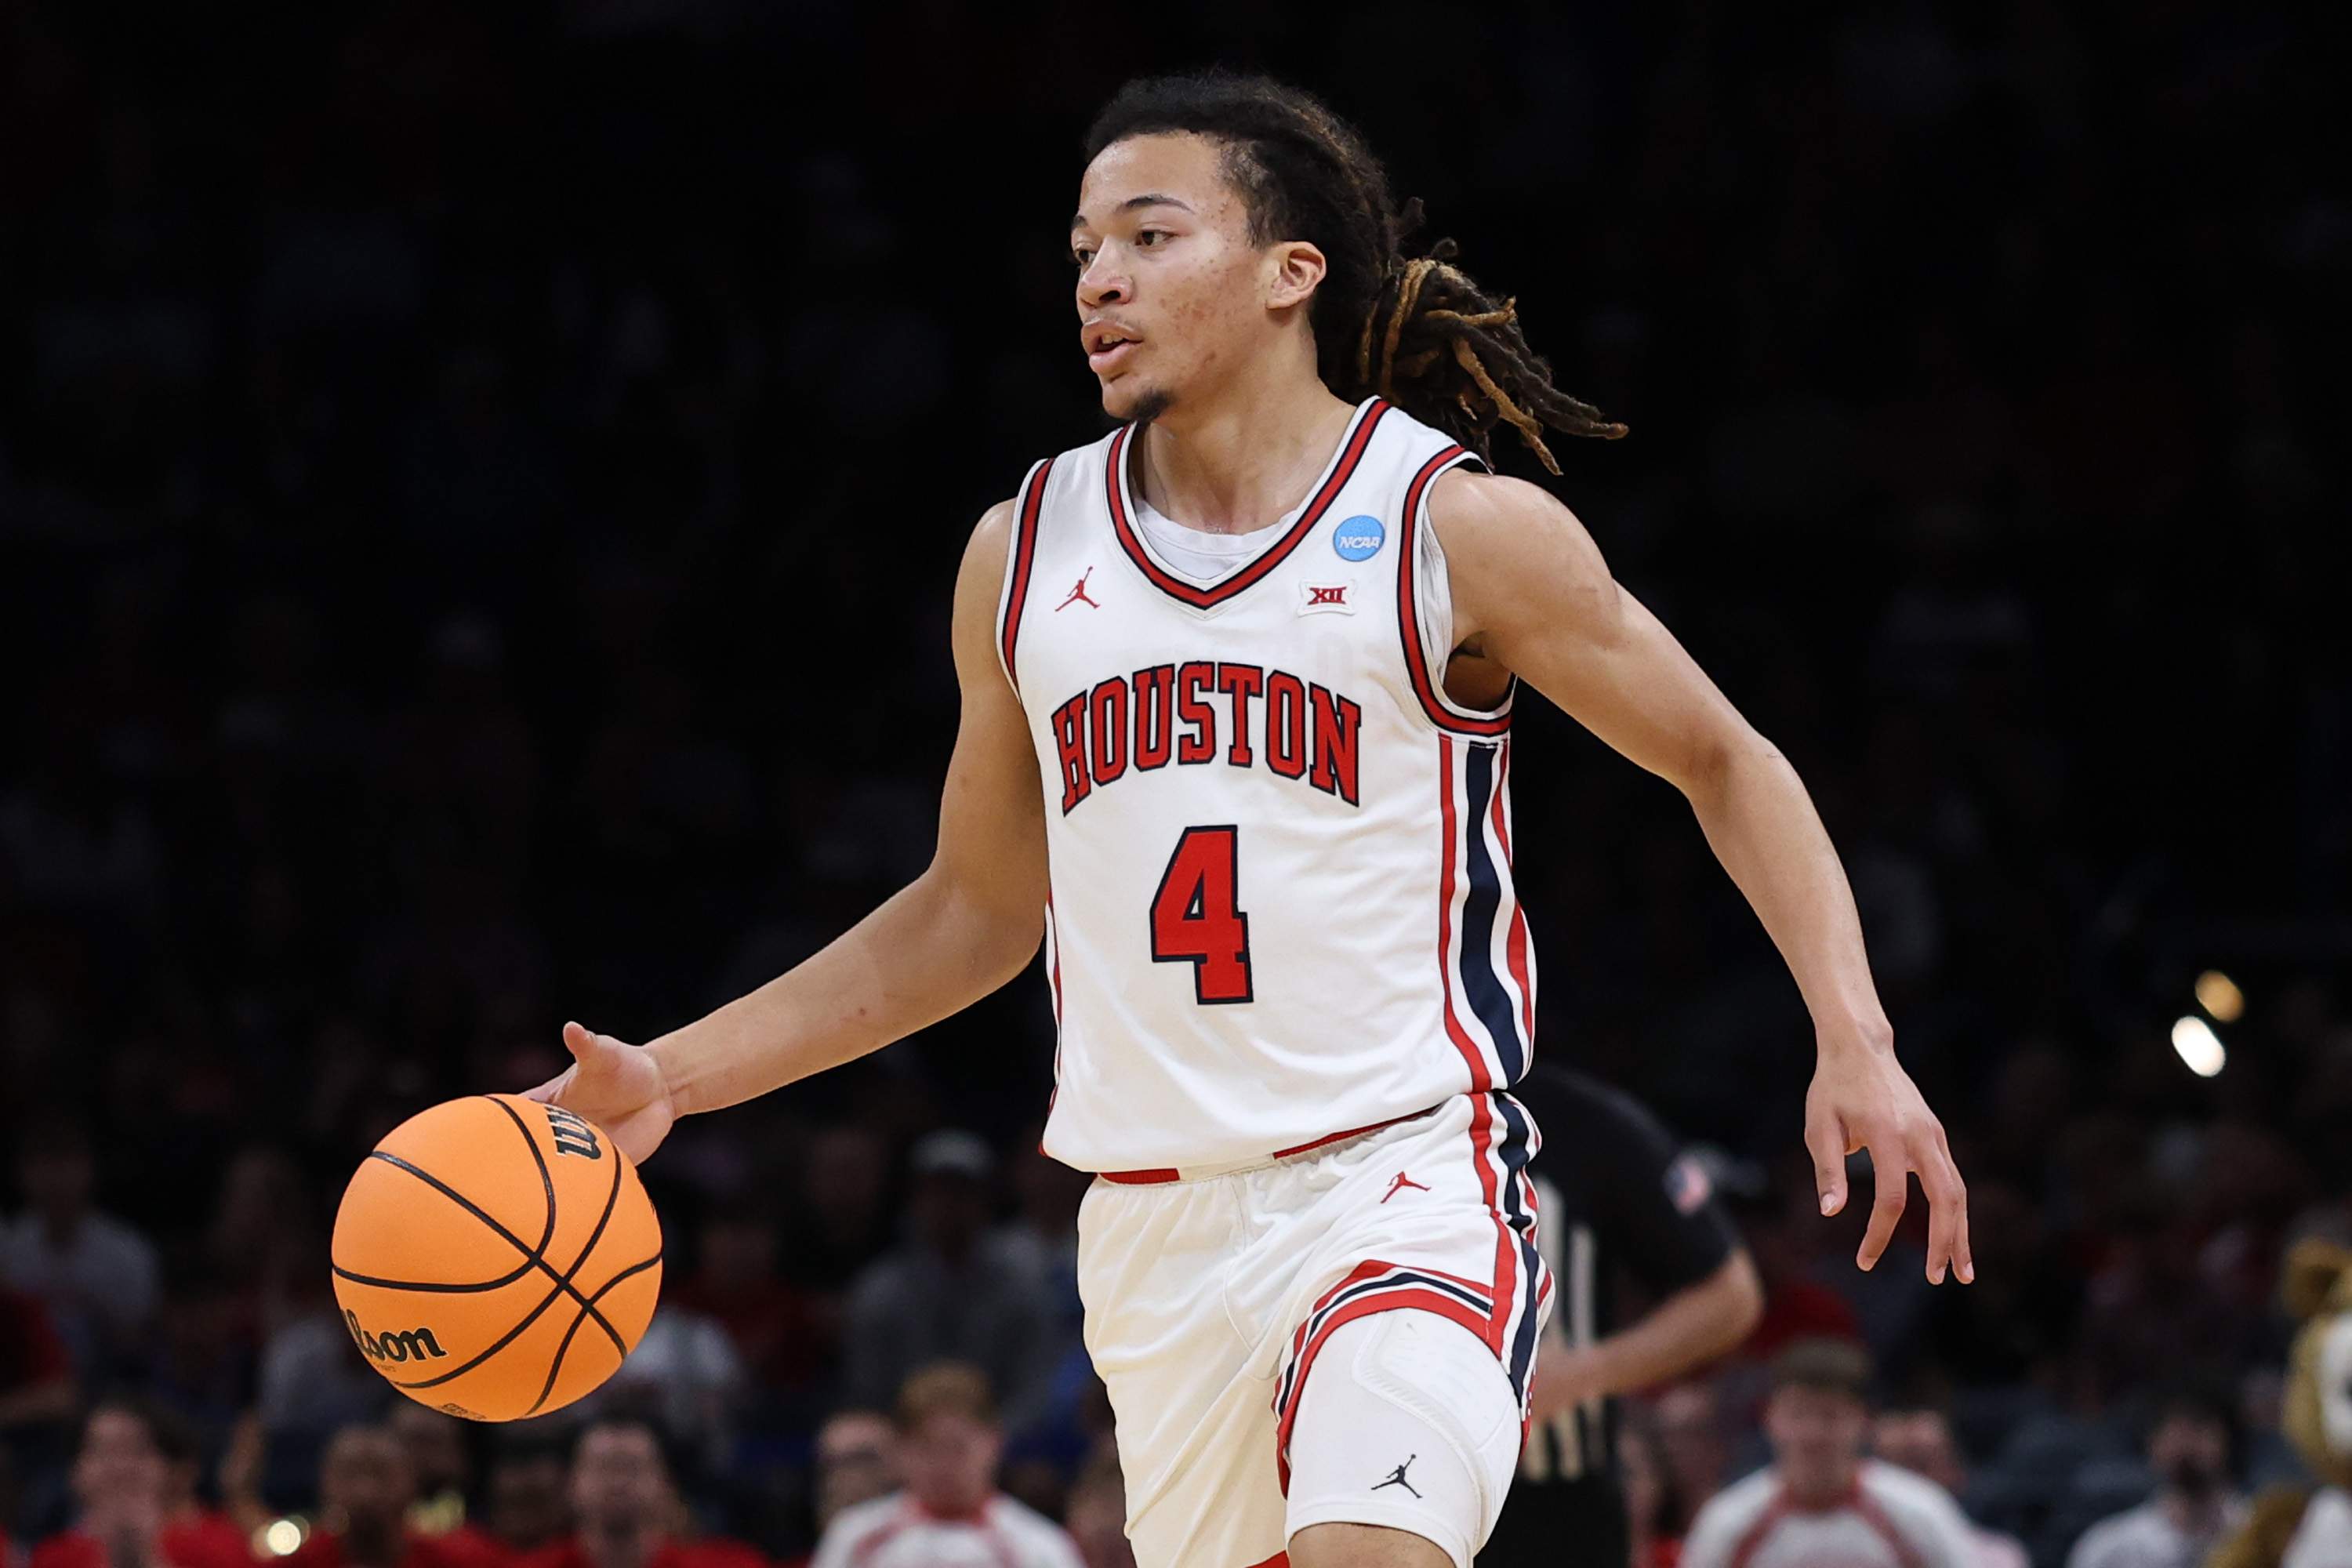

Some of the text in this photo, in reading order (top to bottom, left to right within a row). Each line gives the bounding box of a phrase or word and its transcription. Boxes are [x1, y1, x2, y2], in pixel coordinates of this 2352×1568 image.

[1339, 535, 1381, 549] NCAA
[1308, 586, 1348, 606] XII
[1051, 660, 1361, 817] HOUSTON
[1149, 824, 1254, 1005] 4
[340, 1308, 448, 1362] lson
